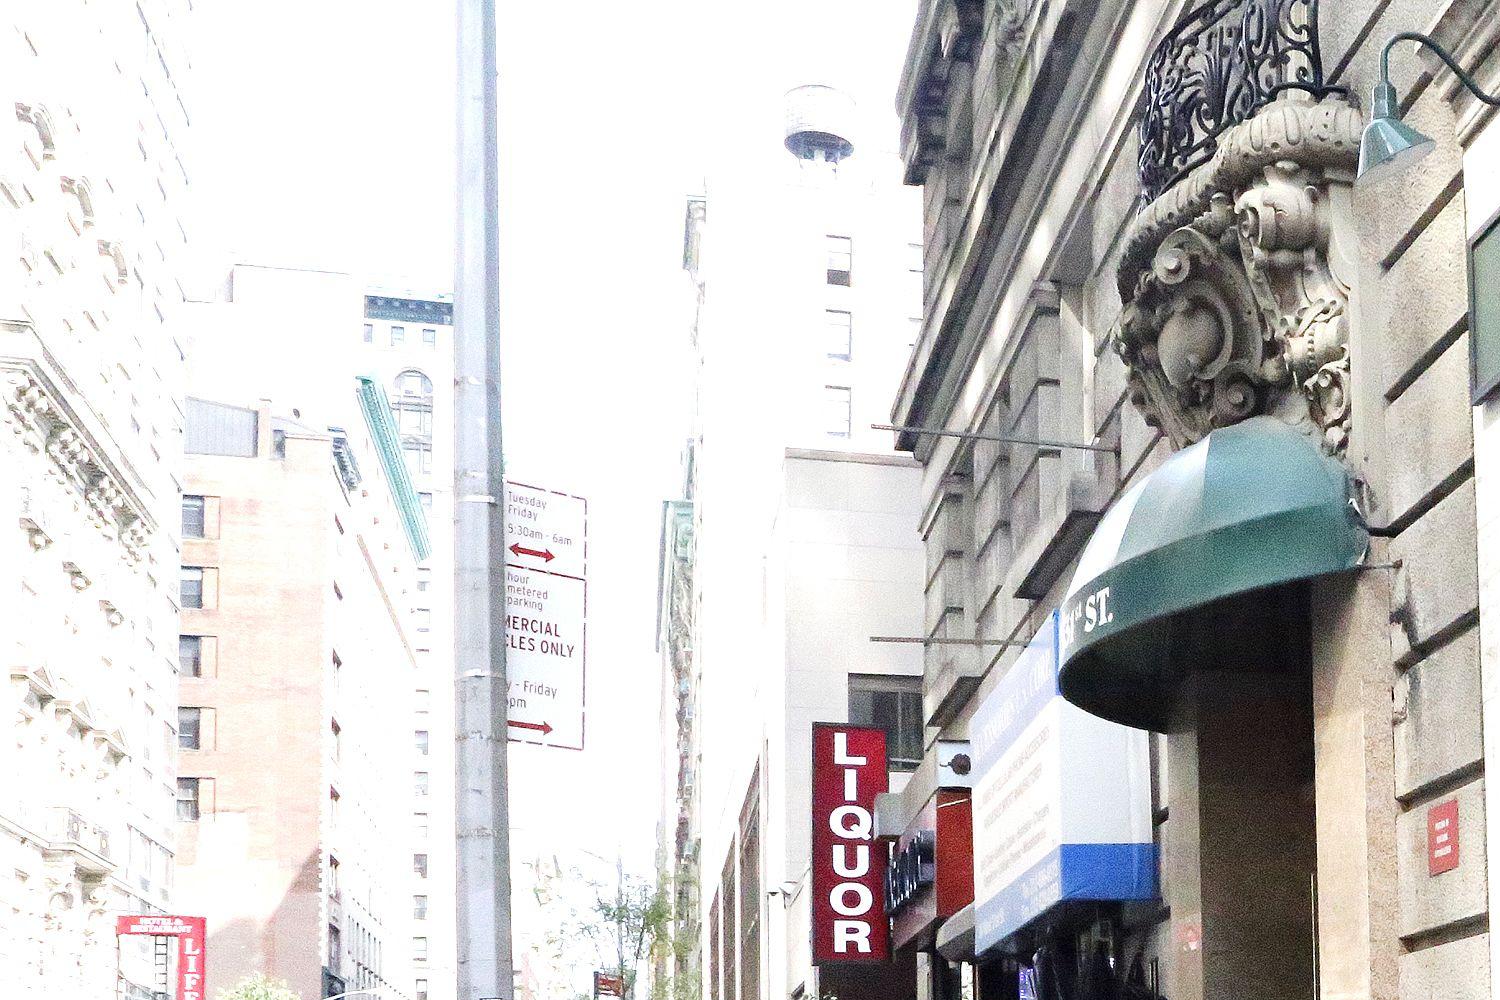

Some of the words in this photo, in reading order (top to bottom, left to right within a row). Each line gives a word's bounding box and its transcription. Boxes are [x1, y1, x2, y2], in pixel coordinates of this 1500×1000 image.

[507, 491, 547, 509] Tuesday
[507, 504, 538, 521] Friday
[507, 584, 548, 600] metered
[507, 596, 543, 612] parking
[540, 640, 575, 658] ONLY
[523, 680, 558, 700] Friday
[506, 697, 527, 709] pm
[829, 732, 874, 954] LIQUOR
